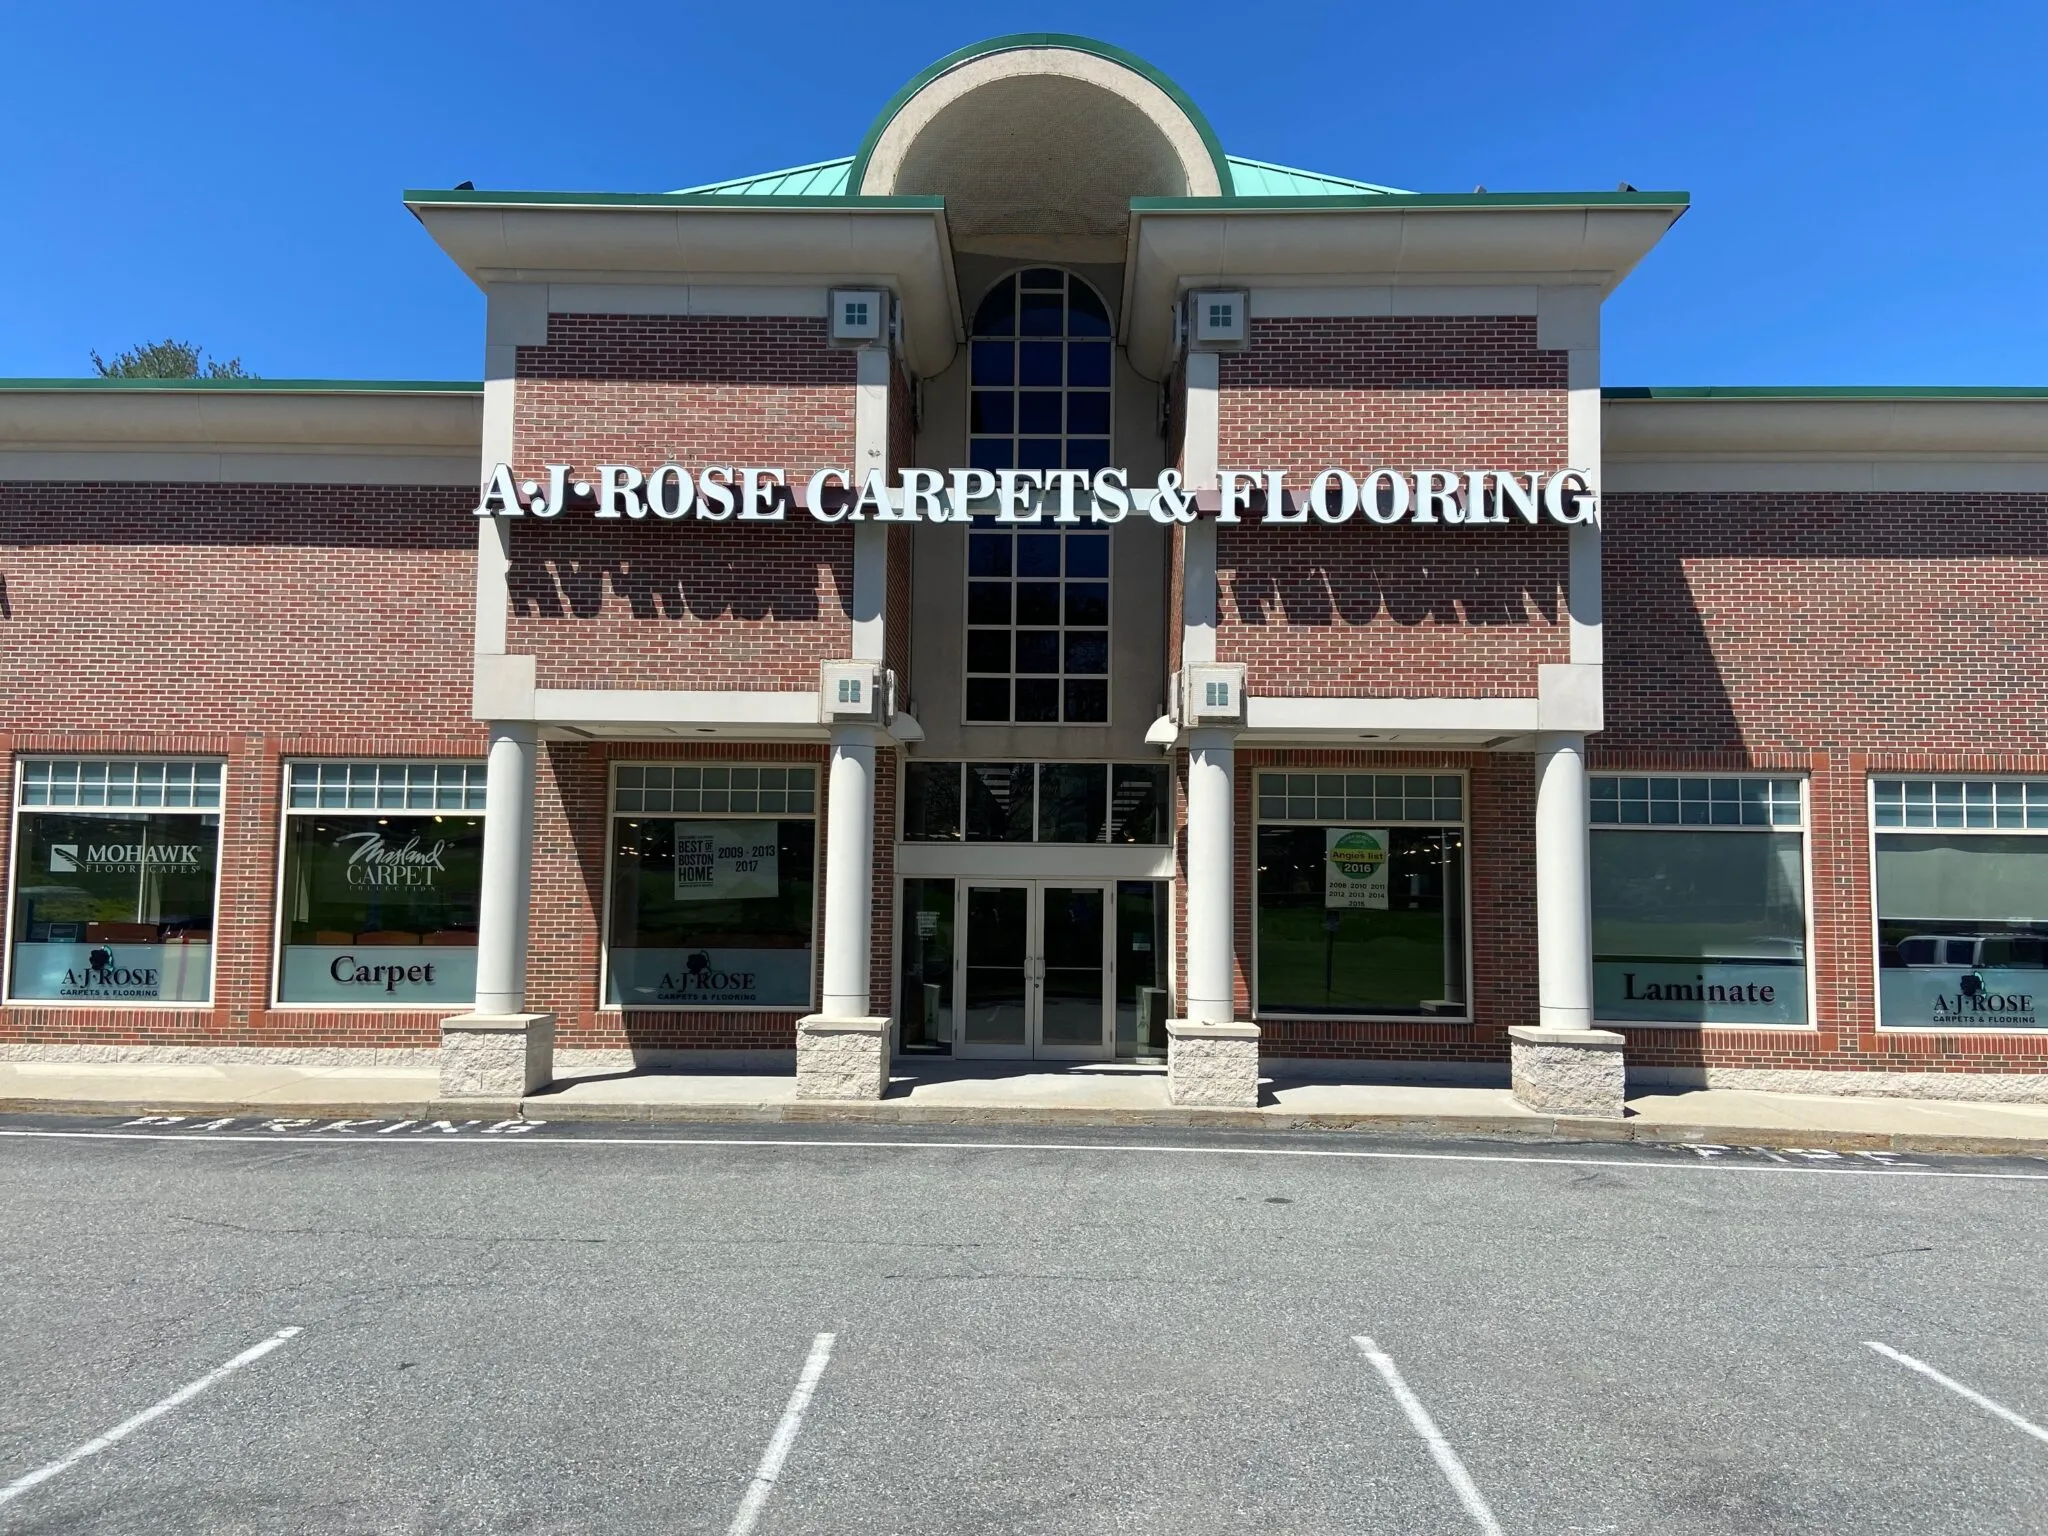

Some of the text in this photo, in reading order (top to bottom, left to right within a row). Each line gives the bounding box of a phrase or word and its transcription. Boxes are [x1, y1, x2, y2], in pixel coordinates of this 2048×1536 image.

[806, 467, 1129, 524] CARPETS
[1149, 467, 1198, 524] &
[1216, 468, 1599, 525] FLOORING
[86, 844, 199, 863] MOHAWK
[678, 840, 714, 854] BEST OF
[718, 847, 744, 859] 2009
[752, 845, 776, 858] 2013
[678, 853, 714, 866] BOSTON
[735, 860, 759, 872] 2017
[86, 865, 196, 873] FLOORCAPES
[679, 866, 714, 882] HOME
[1344, 863, 1372, 873] 2016
[347, 865, 439, 886] CARPET
[330, 956, 435, 992] Carpet
[113, 989, 158, 997] FLOORING
[1623, 973, 1775, 1002] Laminate
[1933, 1015, 1975, 1023] CARPETS
[1988, 1016, 2036, 1024] FLOORING
